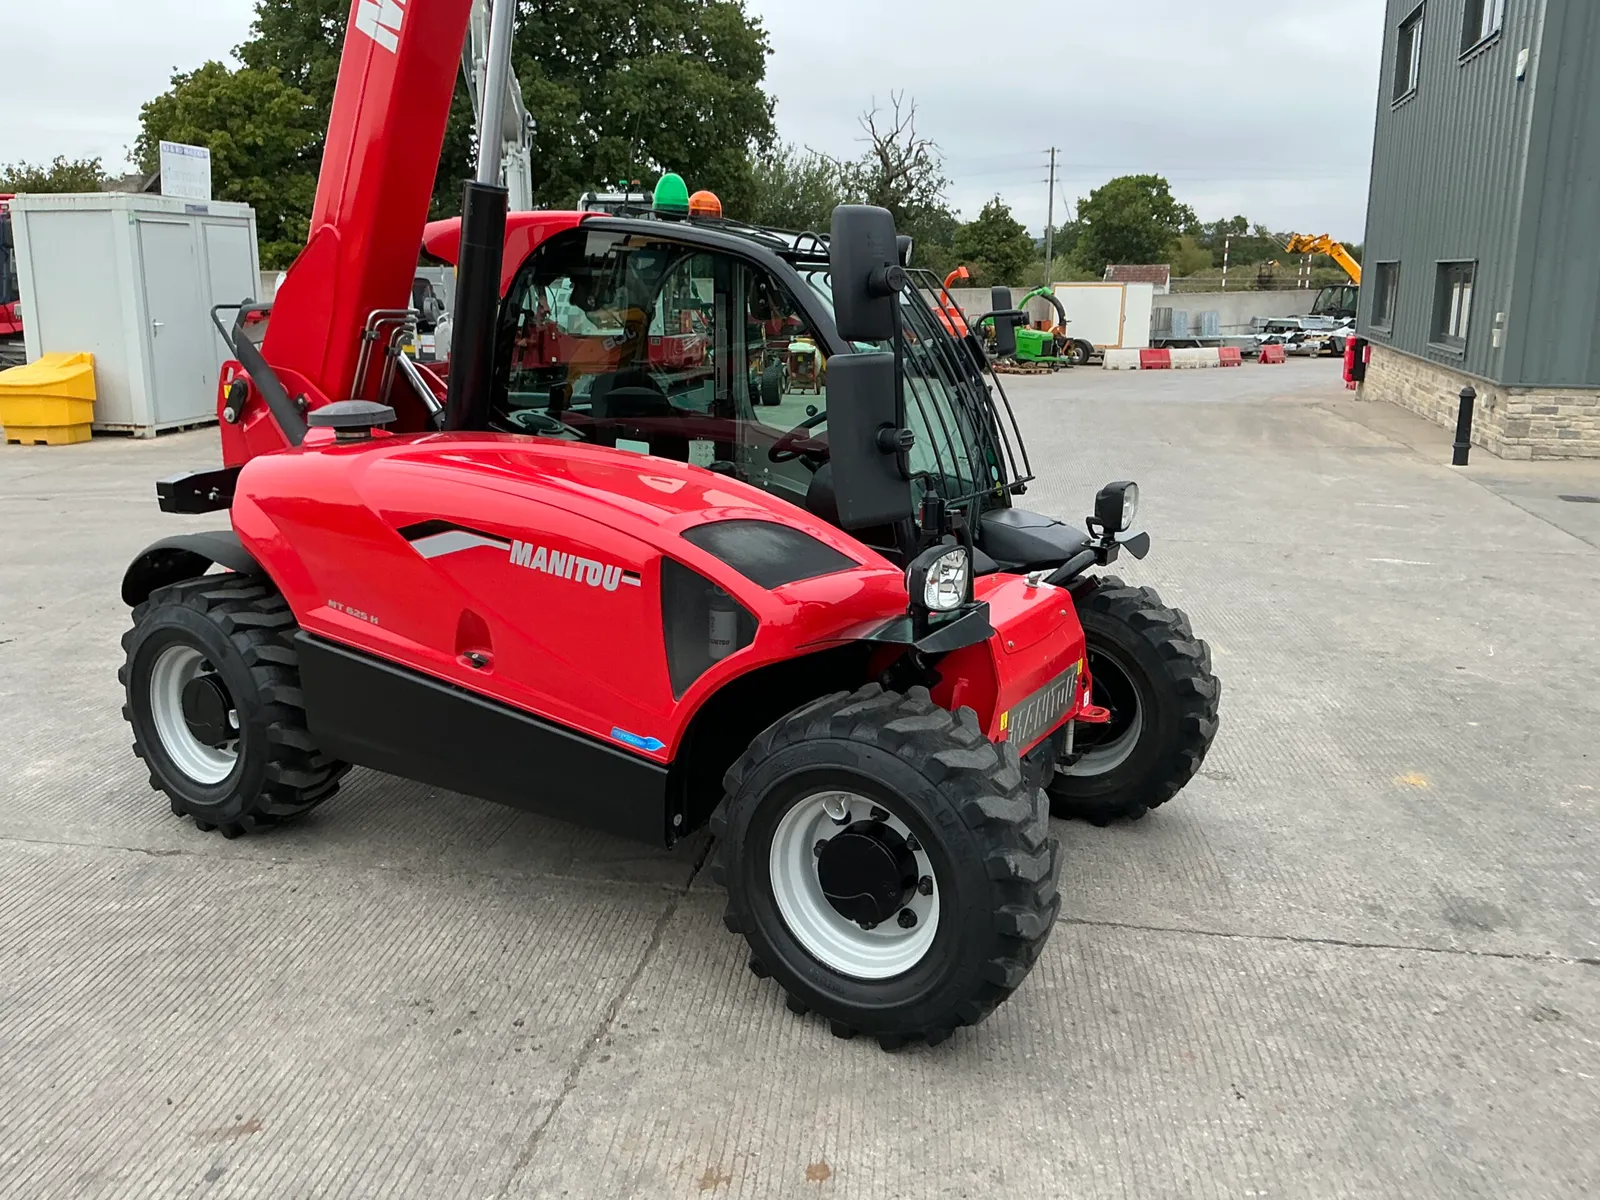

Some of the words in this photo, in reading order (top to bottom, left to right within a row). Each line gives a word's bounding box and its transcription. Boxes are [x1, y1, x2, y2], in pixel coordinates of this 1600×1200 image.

[509, 539, 622, 592] MANITOU
[328, 599, 344, 610] MT
[346, 606, 368, 620] 625
